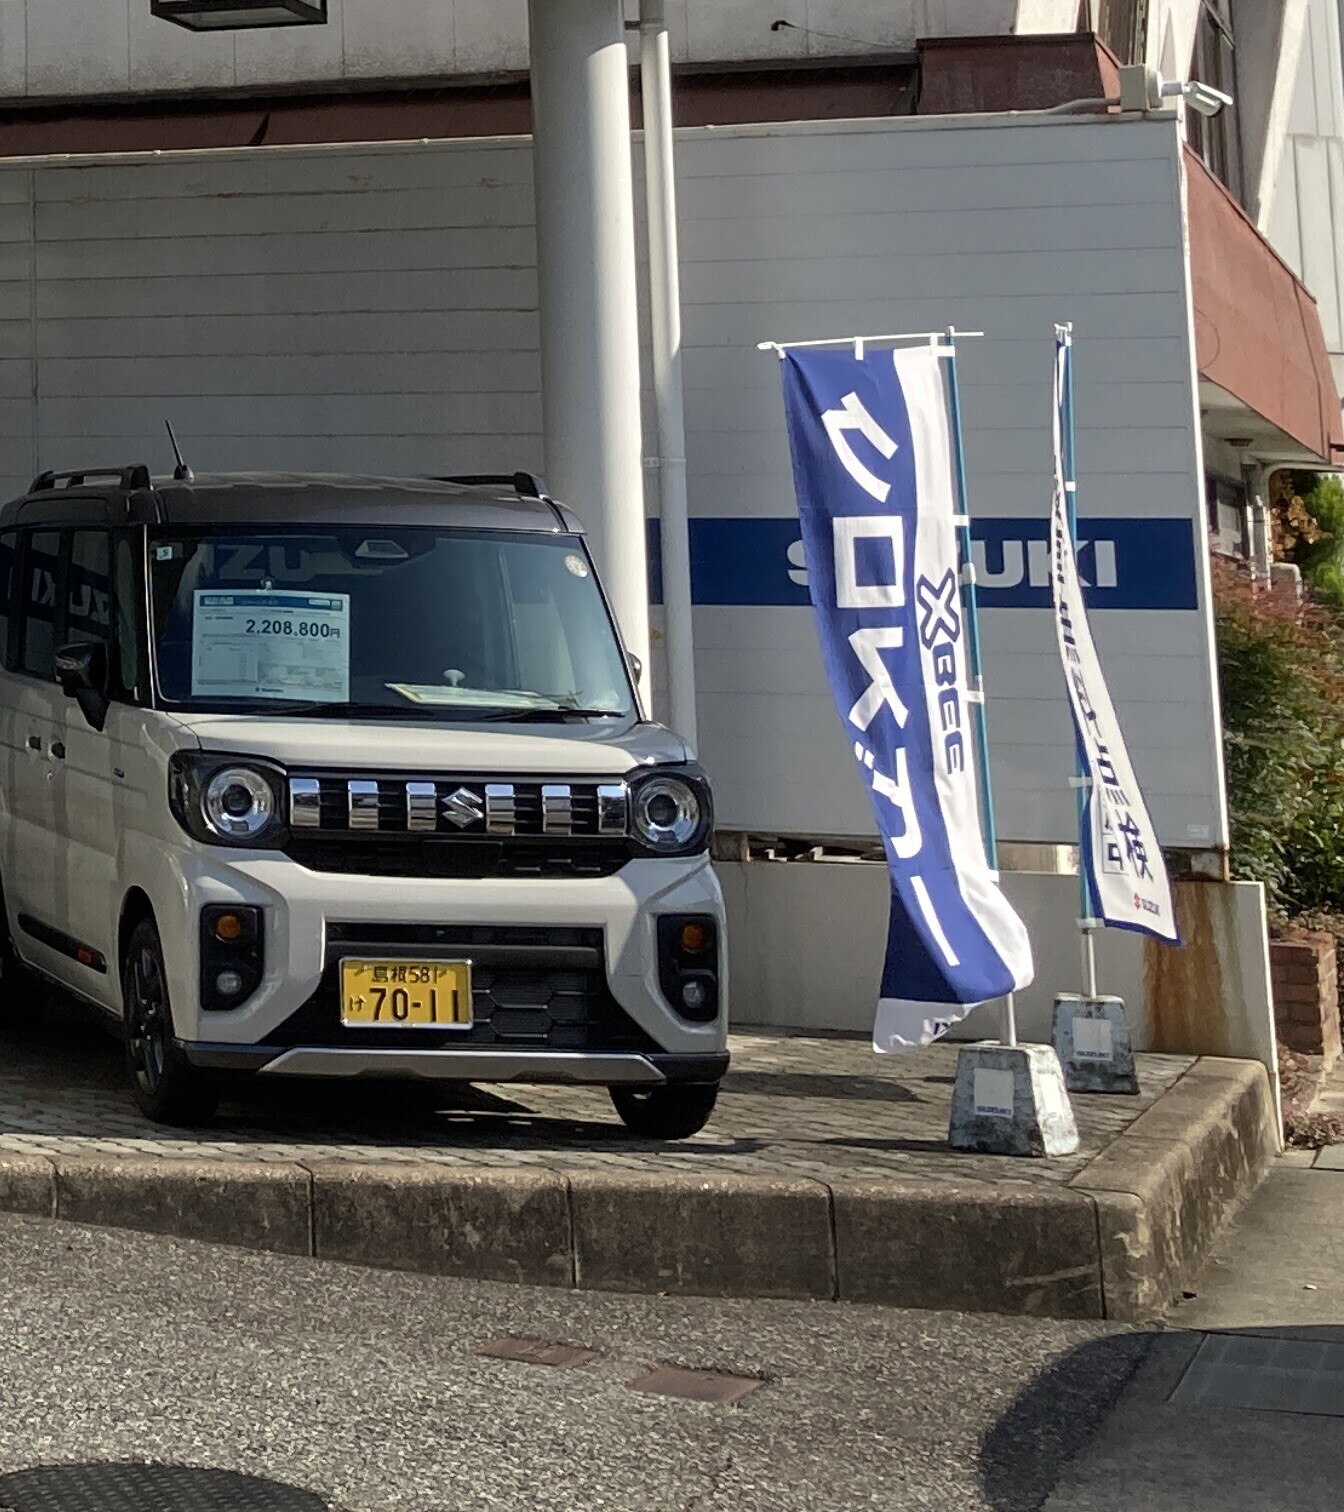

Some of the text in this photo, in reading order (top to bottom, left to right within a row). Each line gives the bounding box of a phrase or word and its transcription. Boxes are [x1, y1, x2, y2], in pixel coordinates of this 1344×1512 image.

[820, 390, 961, 968] クロスビー
[915, 567, 965, 776] XBEE
[369, 987, 459, 1022] 70-11
